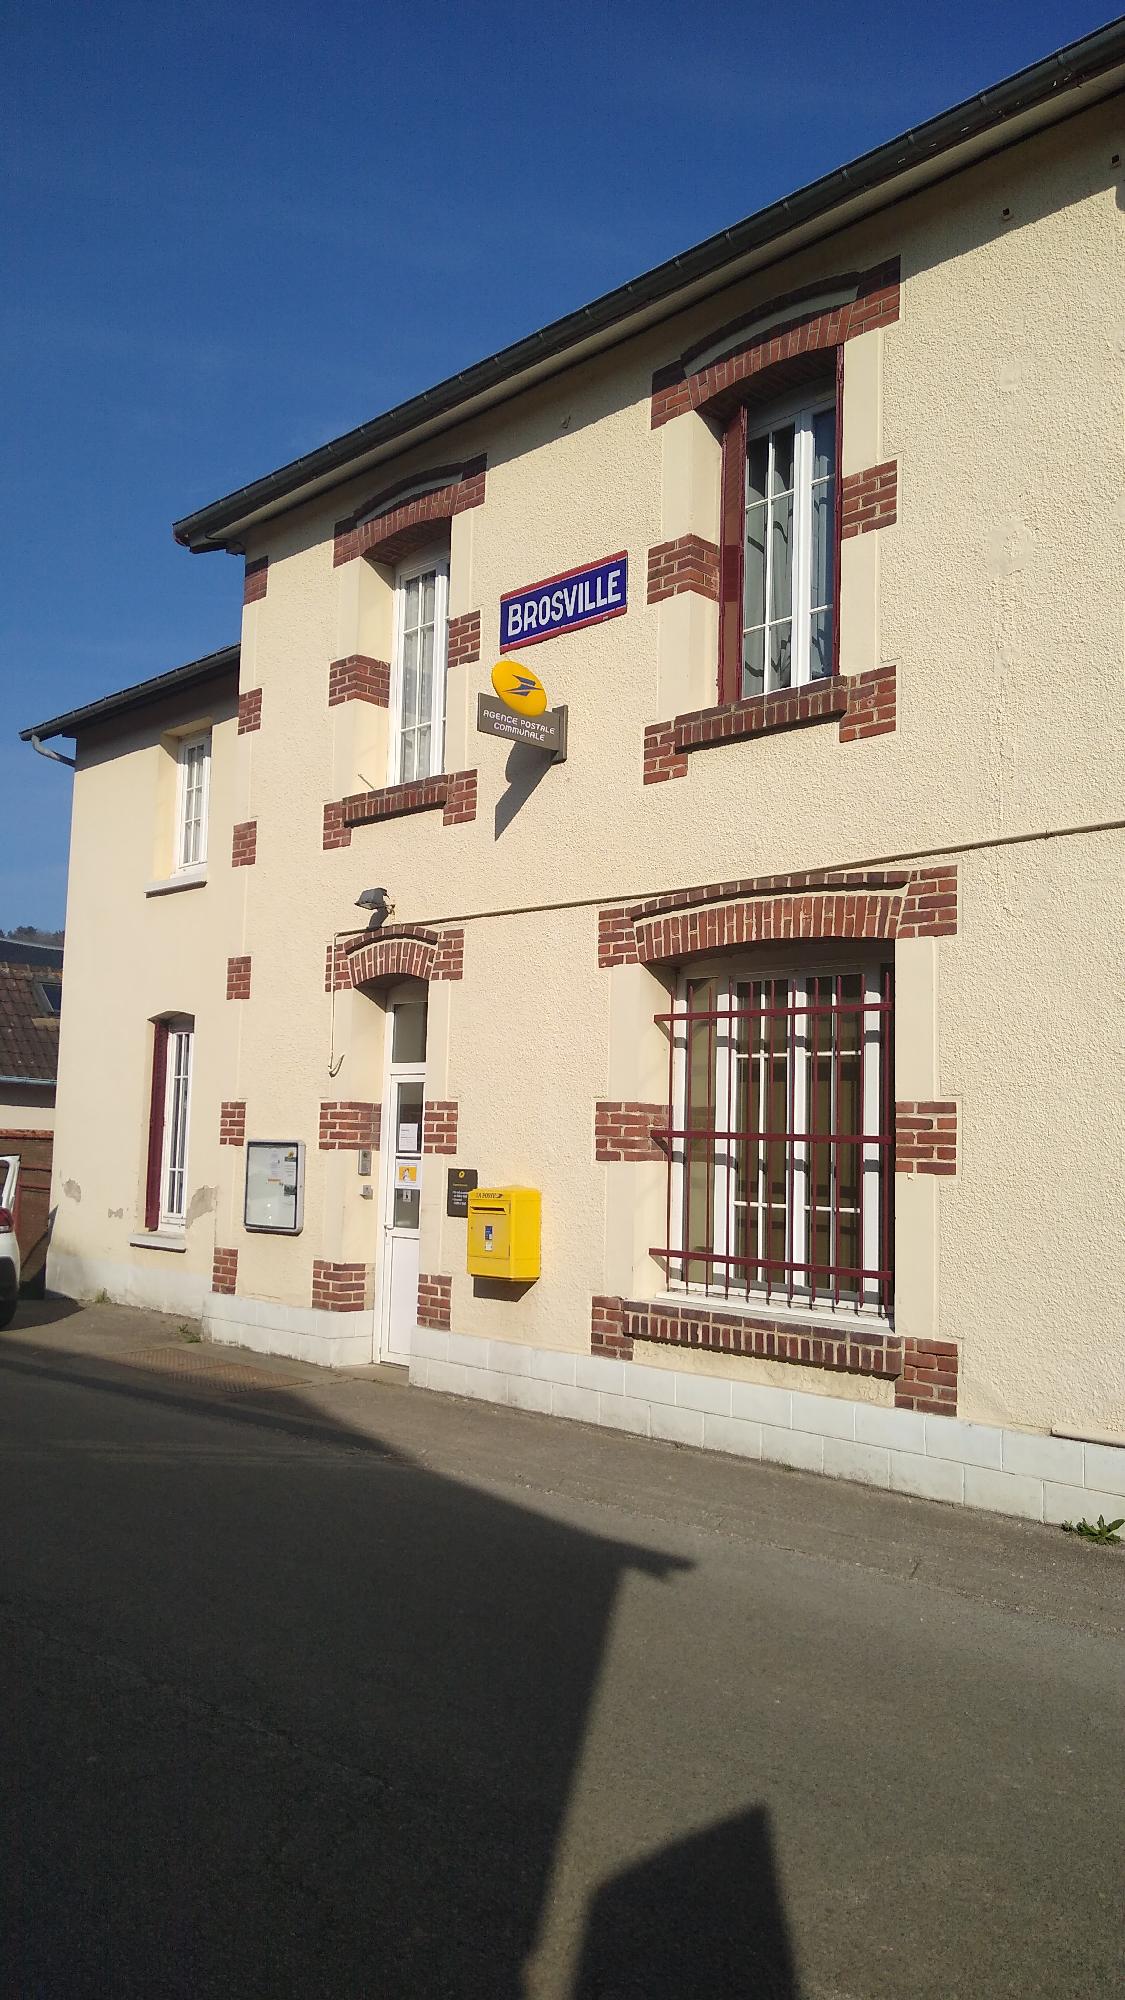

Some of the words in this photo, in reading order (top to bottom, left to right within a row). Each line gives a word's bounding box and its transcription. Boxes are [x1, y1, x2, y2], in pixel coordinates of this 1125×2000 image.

[507, 569, 622, 637] BROSVILLE
[483, 709, 518, 726] AGENCE
[520, 719, 555, 735] POSTALE
[493, 722, 545, 741] COMMUNALE
